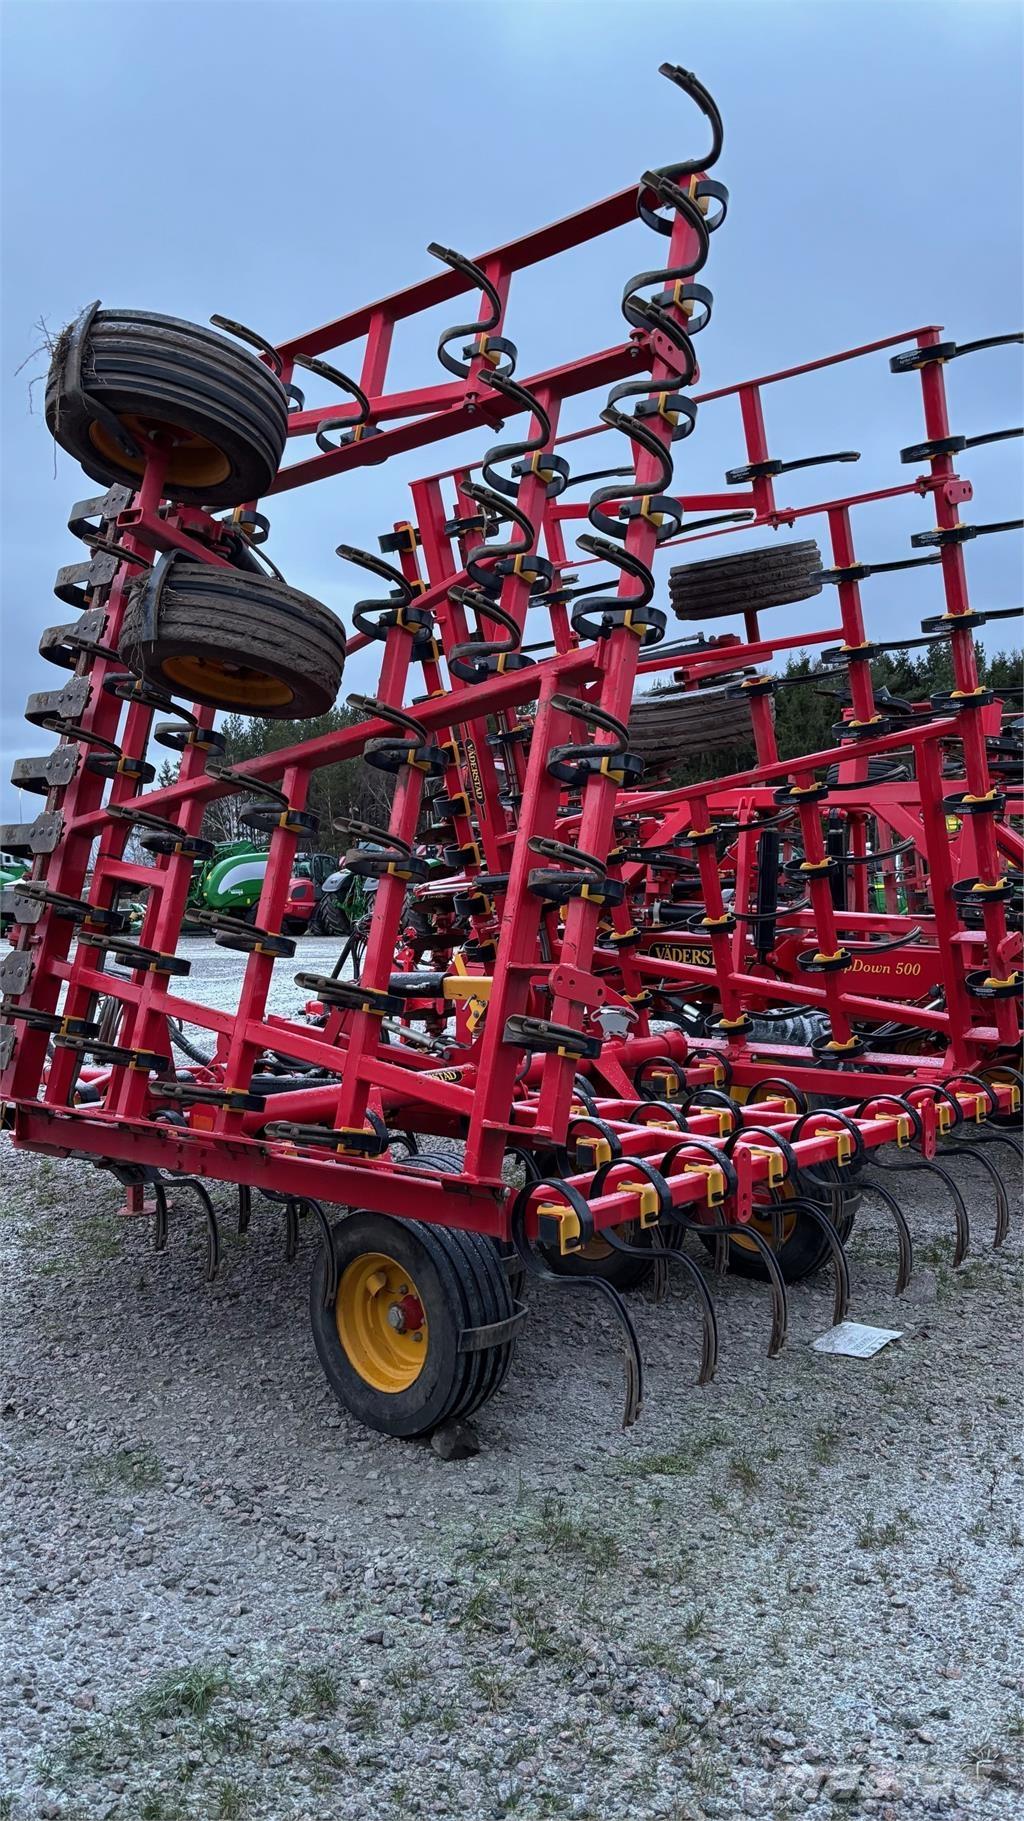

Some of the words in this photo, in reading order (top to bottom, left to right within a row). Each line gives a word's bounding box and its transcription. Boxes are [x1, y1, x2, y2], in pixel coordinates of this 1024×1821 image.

[467, 743, 483, 799] VÄDERSTAD
[655, 944, 716, 965] VÄDERST
[843, 958, 890, 974] pDown
[895, 962, 921, 976] 500
